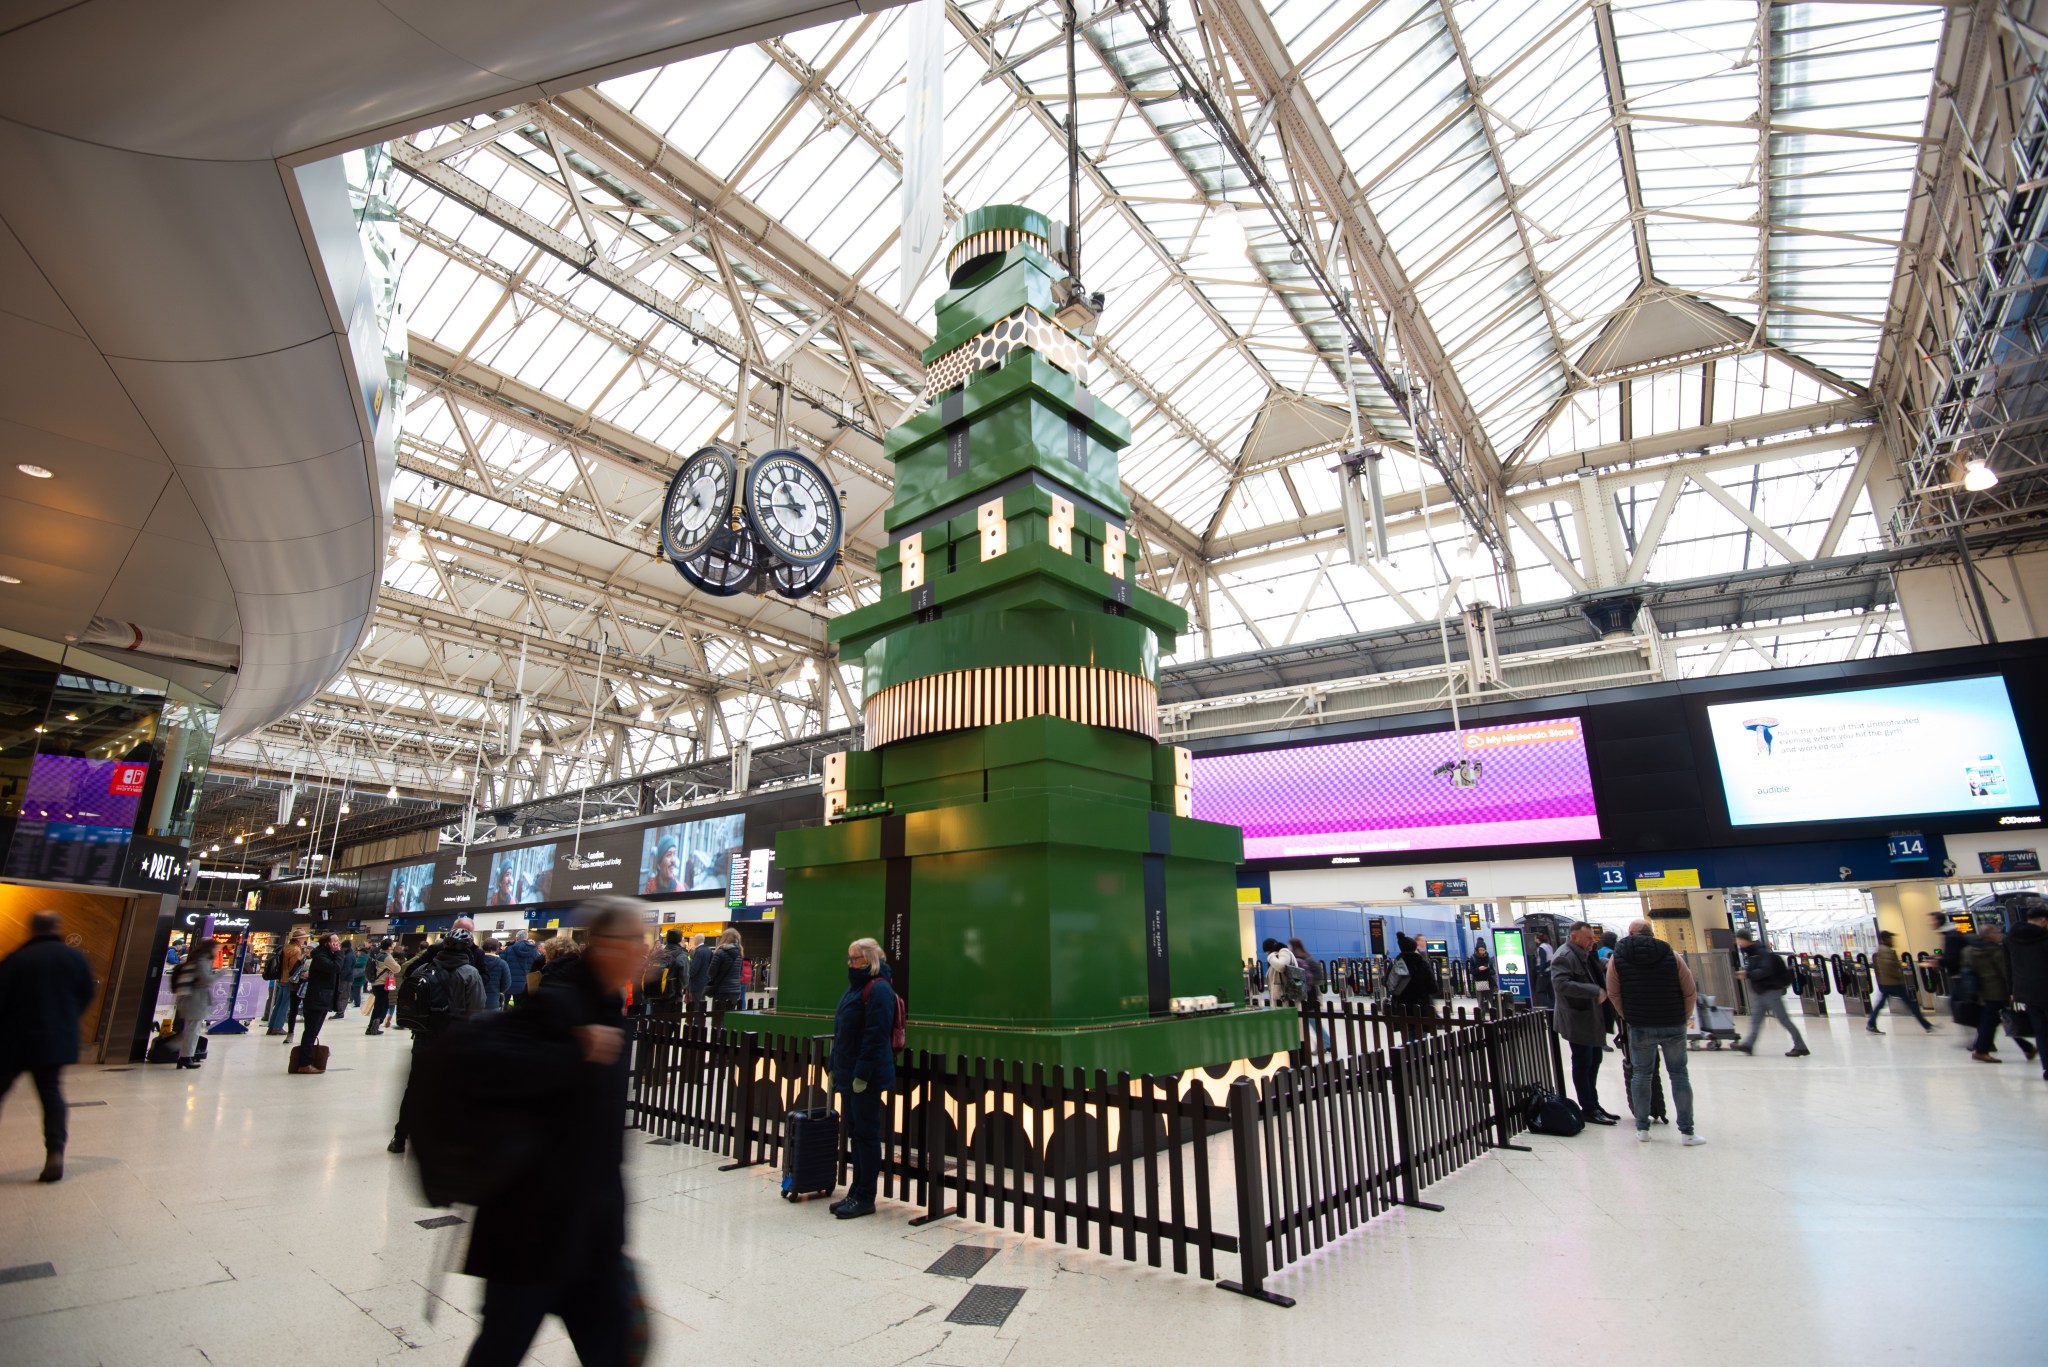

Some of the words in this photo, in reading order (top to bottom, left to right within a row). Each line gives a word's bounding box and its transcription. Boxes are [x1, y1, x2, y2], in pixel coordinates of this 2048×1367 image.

[1485, 735, 1501, 745] My
[1502, 730, 1547, 743] Nintendo
[1548, 728, 1574, 738] Store
[1779, 736, 1812, 745] evening
[1814, 734, 1837, 742] when
[1839, 733, 1854, 741] you
[1884, 728, 1903, 736] gym
[1799, 743, 1829, 752] worked
[1757, 786, 1790, 795] audible
[1900, 840, 1923, 855] 14
[2017, 853, 2036, 861] WiFi
[149, 853, 175, 881] PRET
[1603, 870, 1623, 884] 13
[894, 934, 902, 961] spade
[1155, 931, 1163, 957] spade
